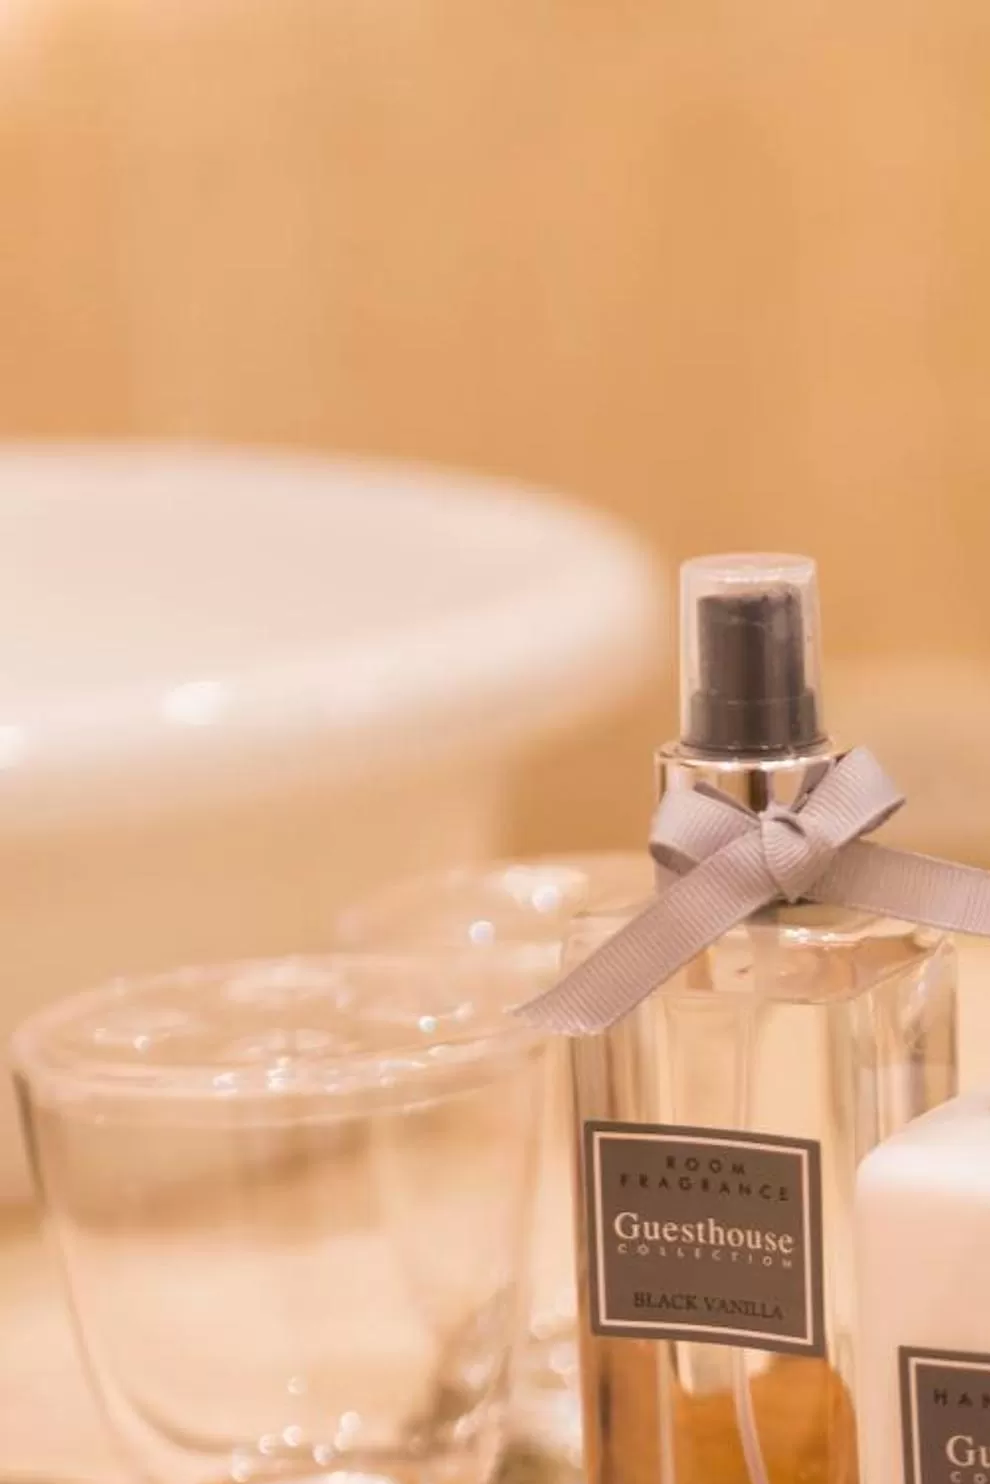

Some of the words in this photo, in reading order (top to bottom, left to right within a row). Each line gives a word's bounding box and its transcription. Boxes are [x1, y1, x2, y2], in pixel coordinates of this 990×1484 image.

[666, 1155, 746, 1175] ROOM
[620, 1173, 789, 1201] FRAGRANCE
[614, 1211, 794, 1254] Guesthouse
[618, 1243, 793, 1268] COLLECTION
[633, 1291, 697, 1311] BLACK
[704, 1296, 783, 1320] VANILLA
